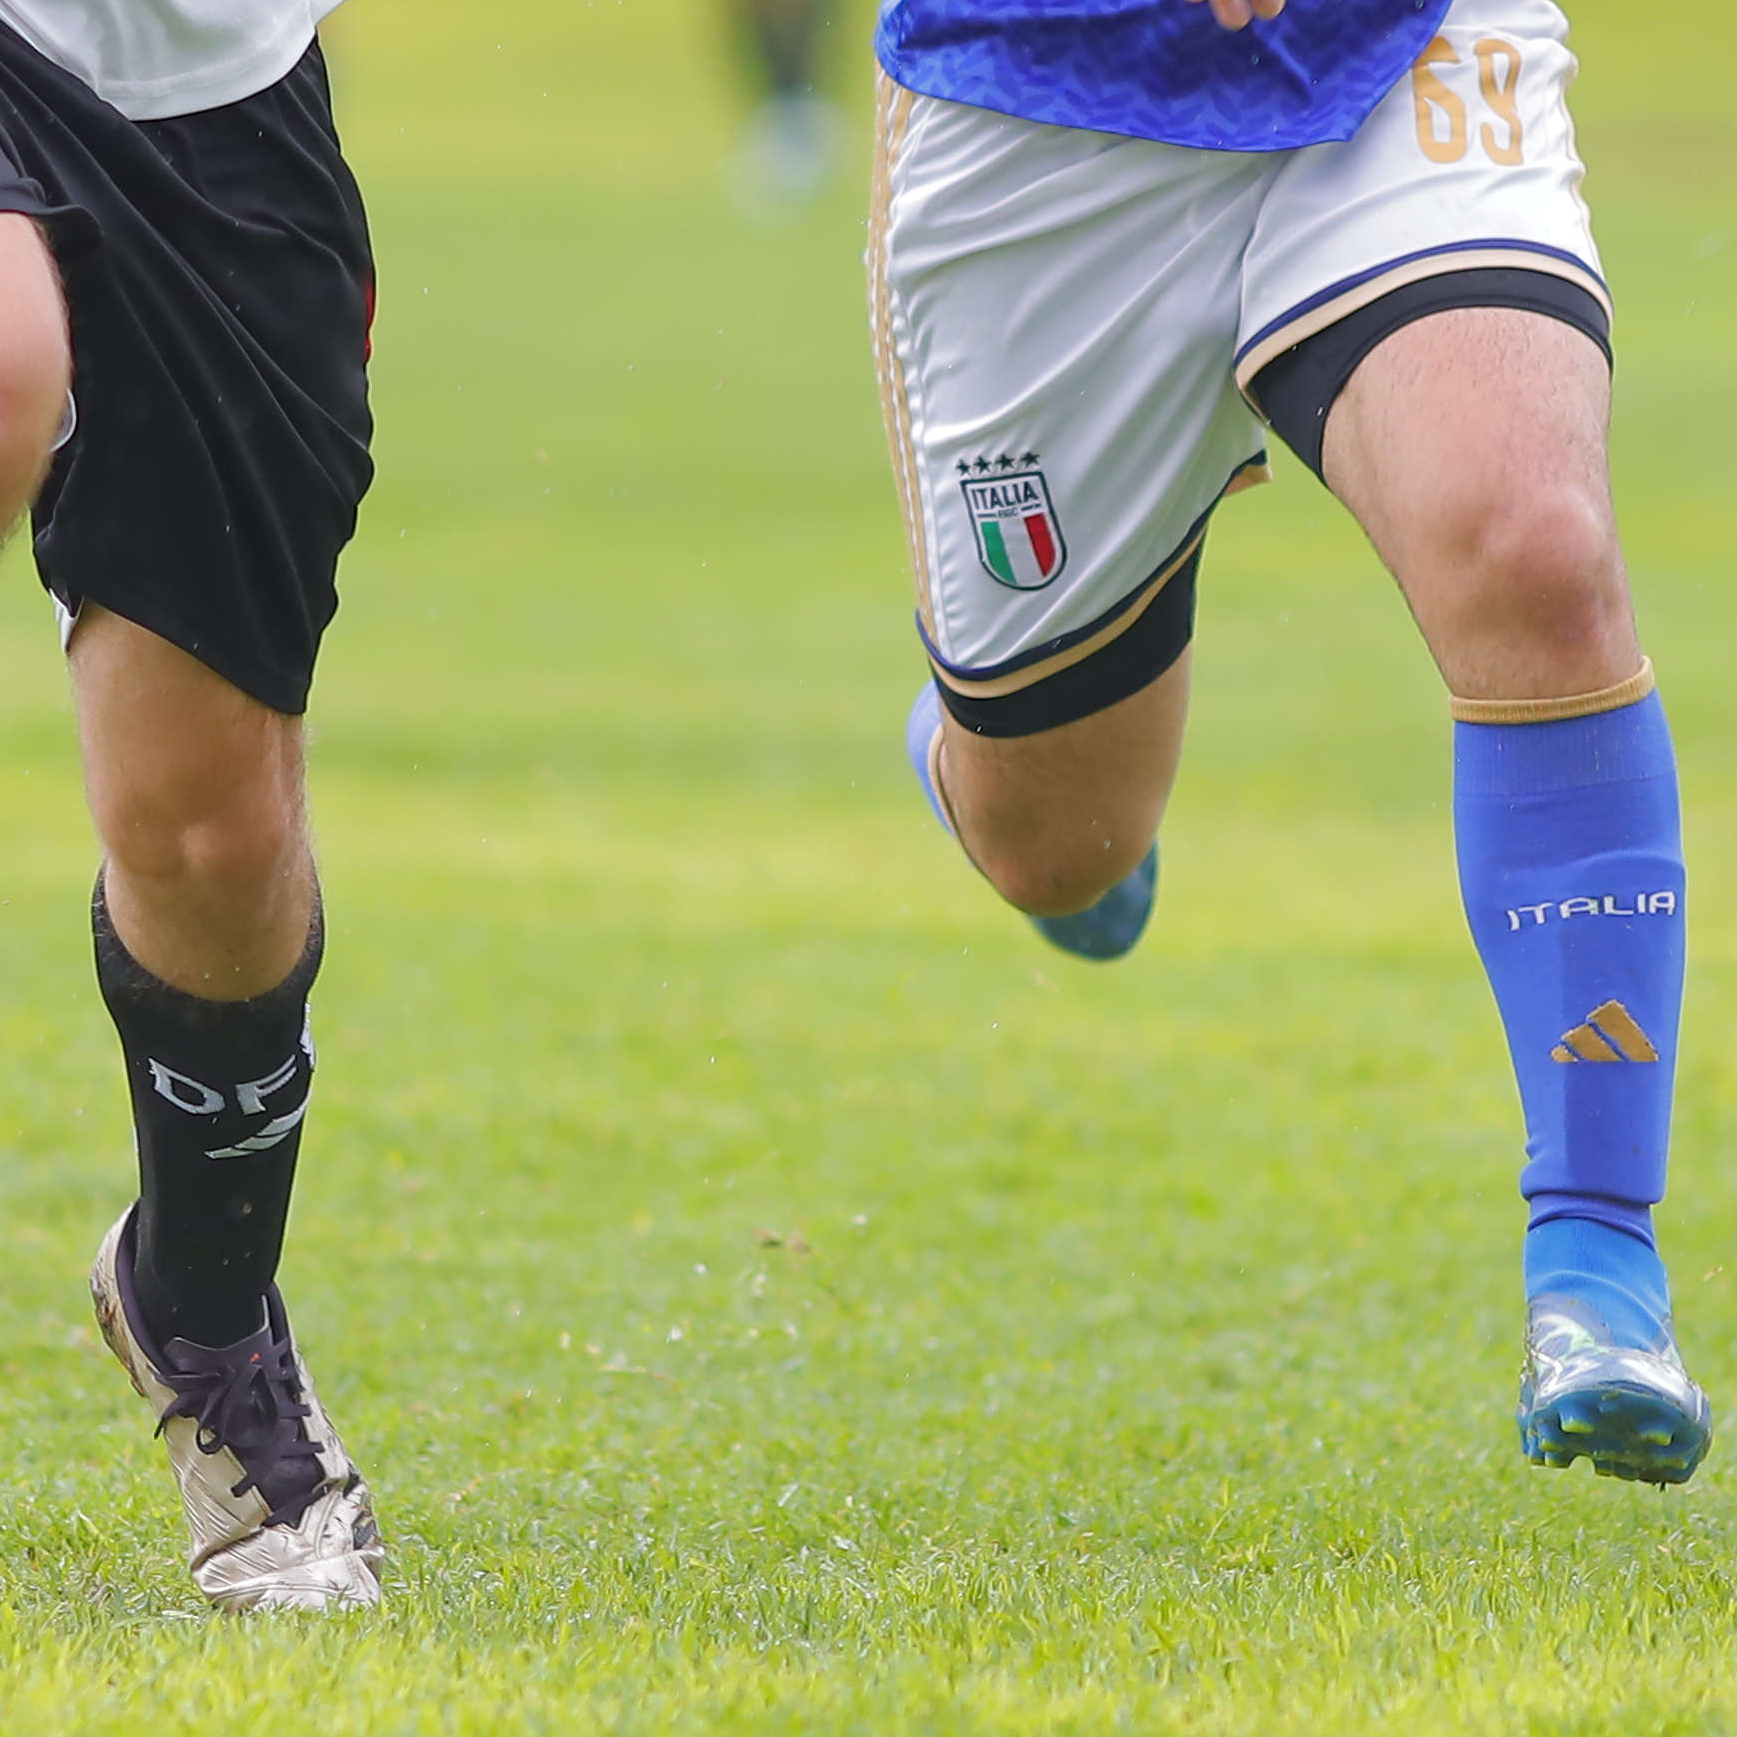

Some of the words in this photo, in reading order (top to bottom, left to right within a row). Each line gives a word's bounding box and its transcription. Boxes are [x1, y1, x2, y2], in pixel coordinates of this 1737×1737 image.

[1412, 36, 1525, 166] 69
[971, 481, 1039, 510] ITALIA
[1507, 891, 1676, 931] ITALIA
